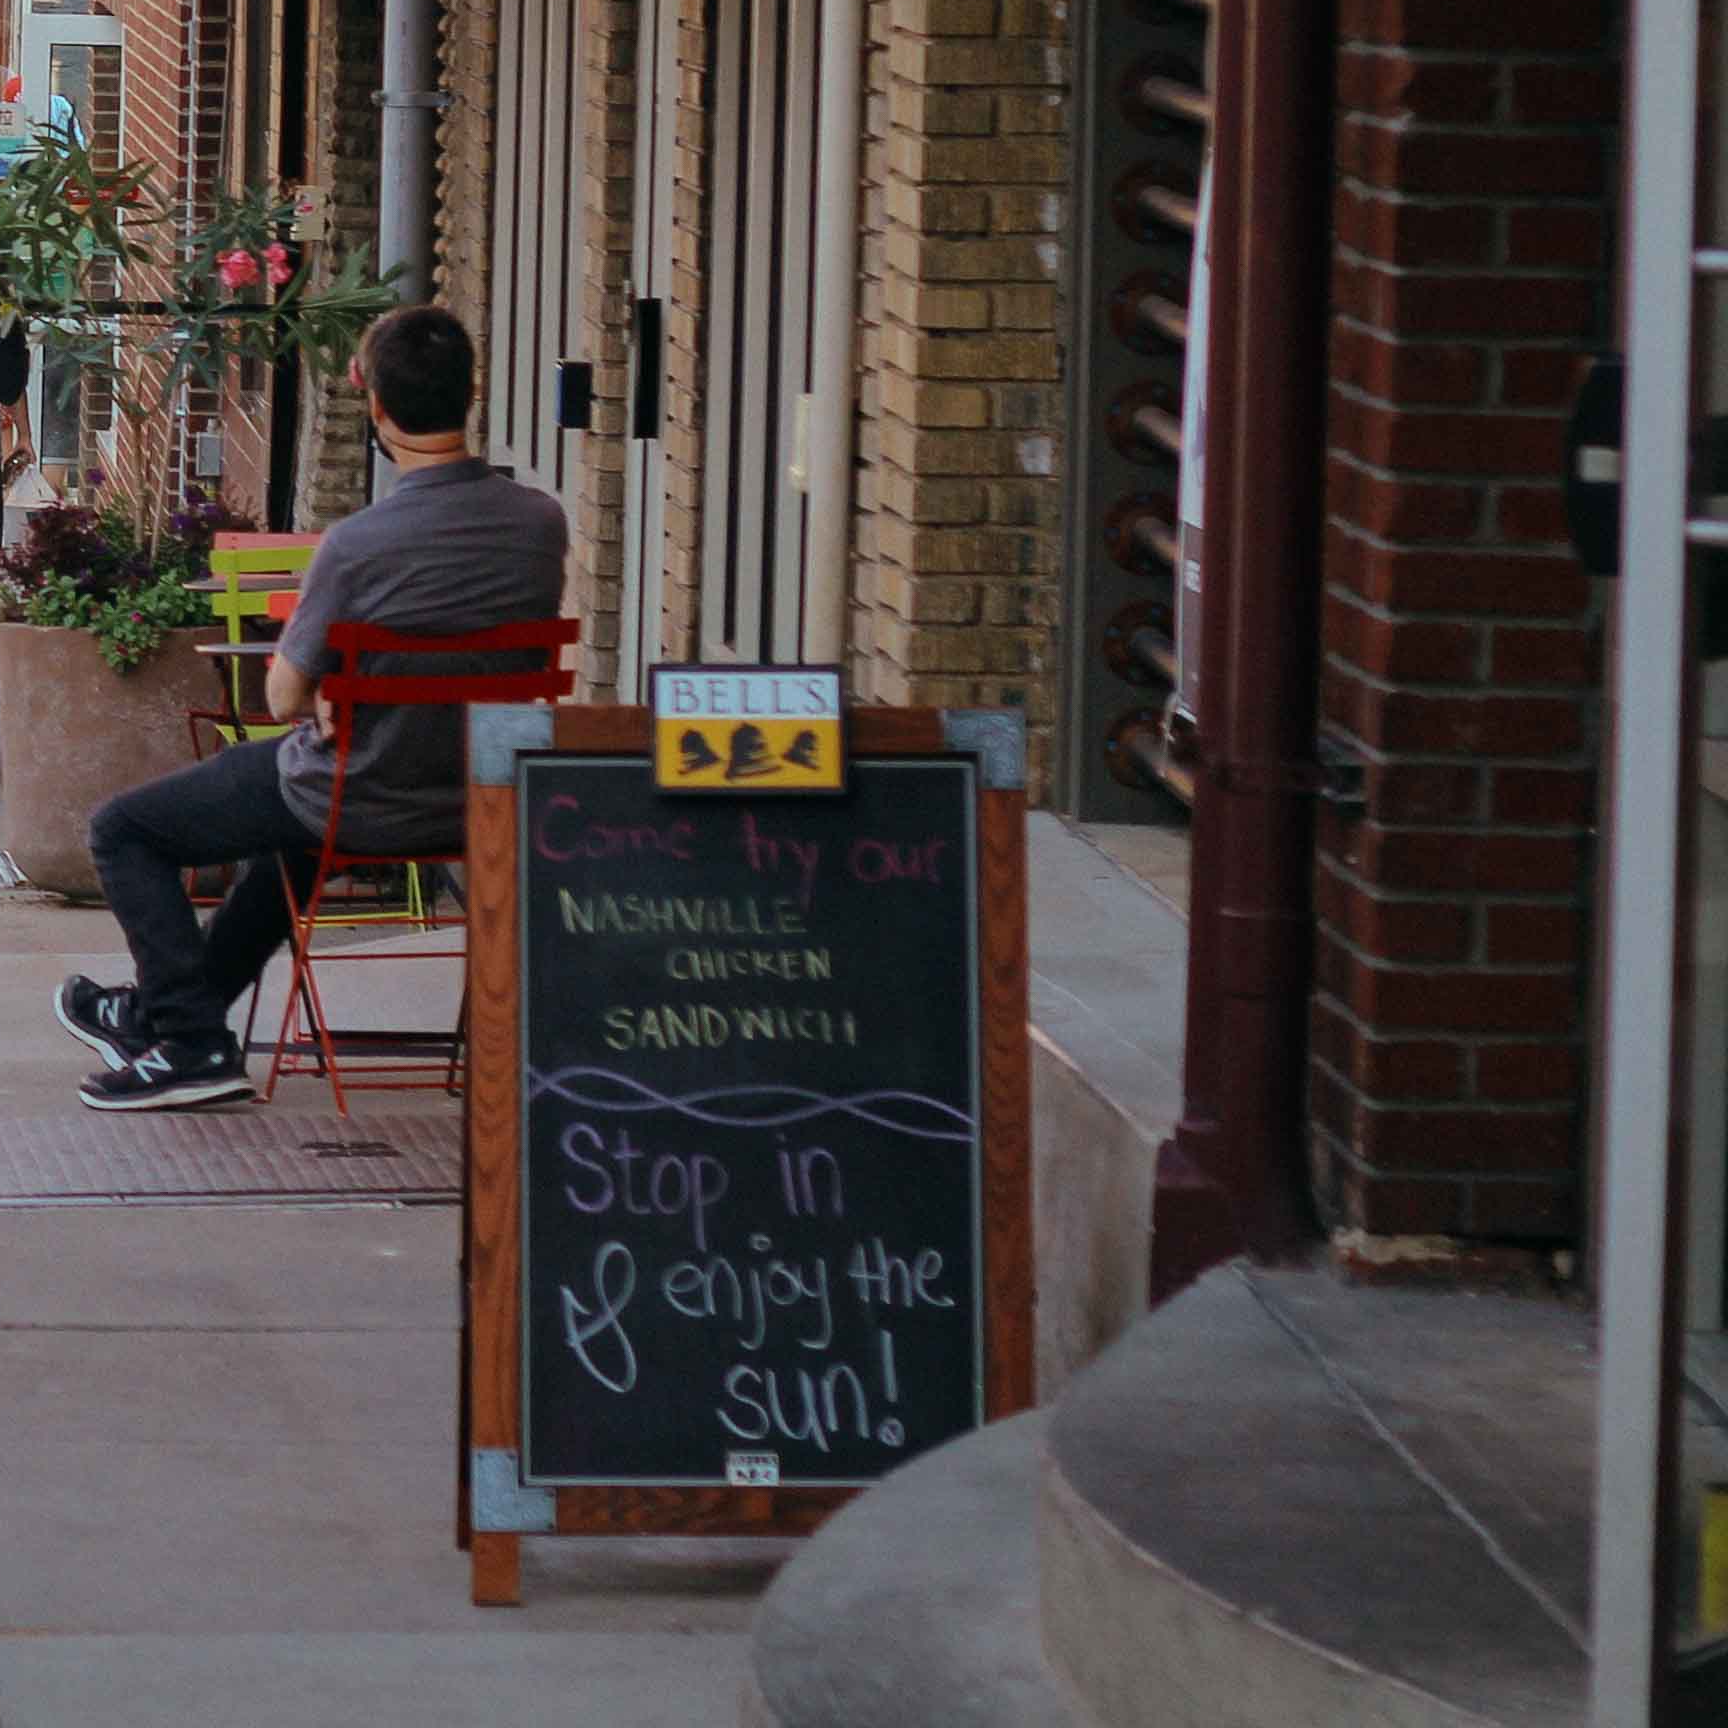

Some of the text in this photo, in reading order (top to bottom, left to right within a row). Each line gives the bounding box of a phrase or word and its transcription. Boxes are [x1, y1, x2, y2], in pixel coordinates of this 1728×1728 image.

[671, 678, 831, 715] BELL'S
[532, 793, 700, 863] Come
[850, 836, 948, 887] our
[557, 886, 809, 935] NASHVILLE
[665, 945, 833, 983] CHICKEN
[602, 1002, 861, 1052] SANDWICH
[560, 1122, 843, 1252] Stop in
[660, 1233, 834, 1352] enjoy
[847, 1236, 956, 1309] the
[715, 1329, 906, 1453] sun!
